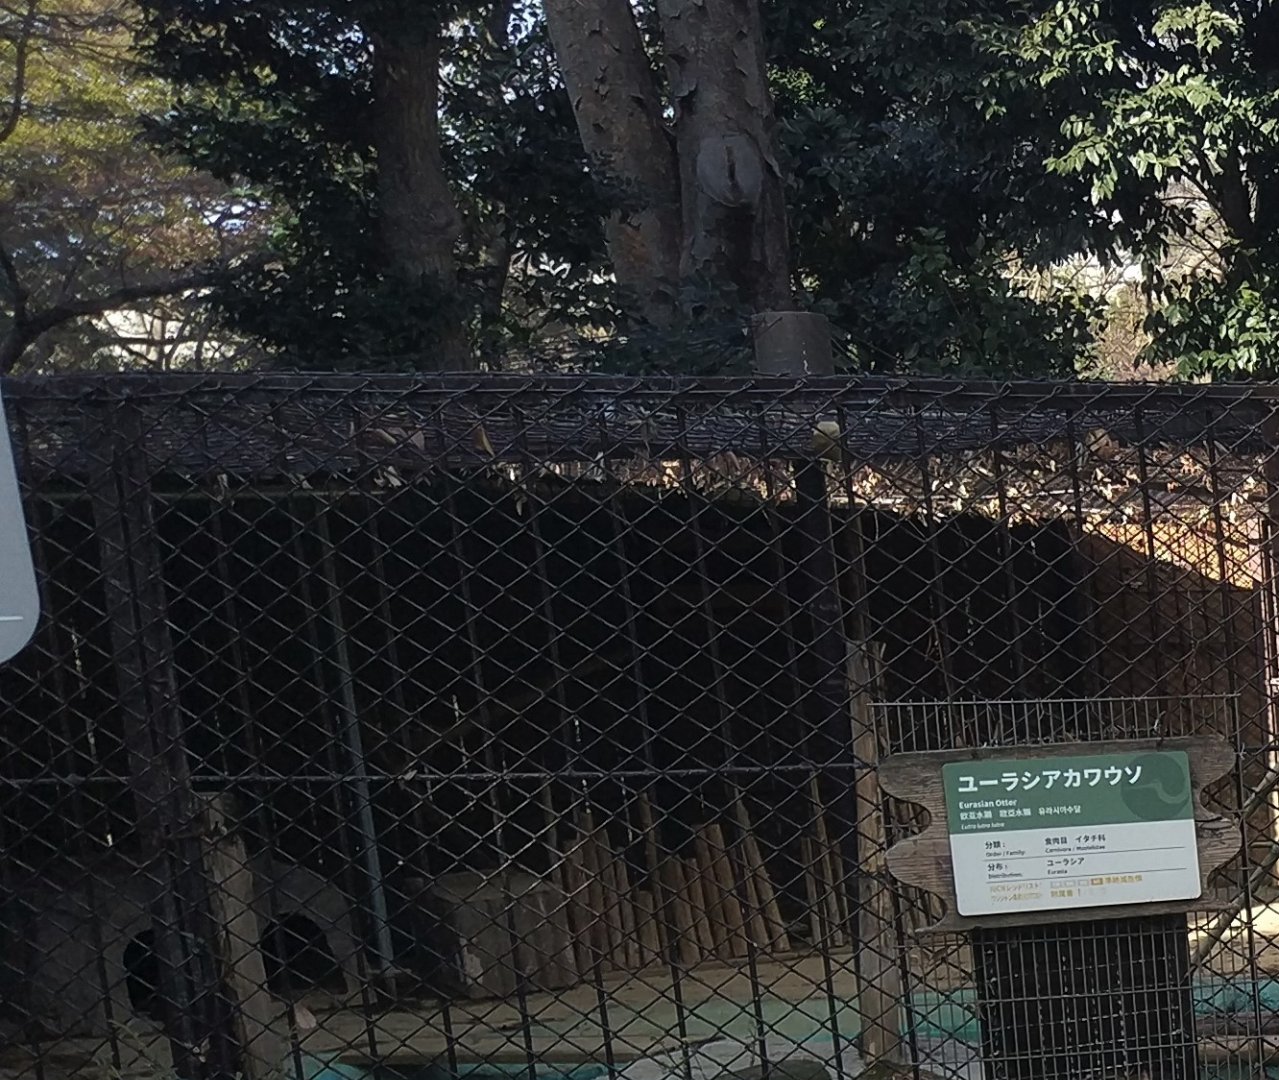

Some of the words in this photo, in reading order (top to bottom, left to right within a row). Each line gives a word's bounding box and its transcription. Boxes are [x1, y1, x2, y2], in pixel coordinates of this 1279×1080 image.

[958, 765, 1142, 793] ユーラシアカワウソ
[959, 800, 994, 809] Eurasian
[995, 799, 1018, 807] Otter
[1047, 858, 1084, 867] ユーラシア
